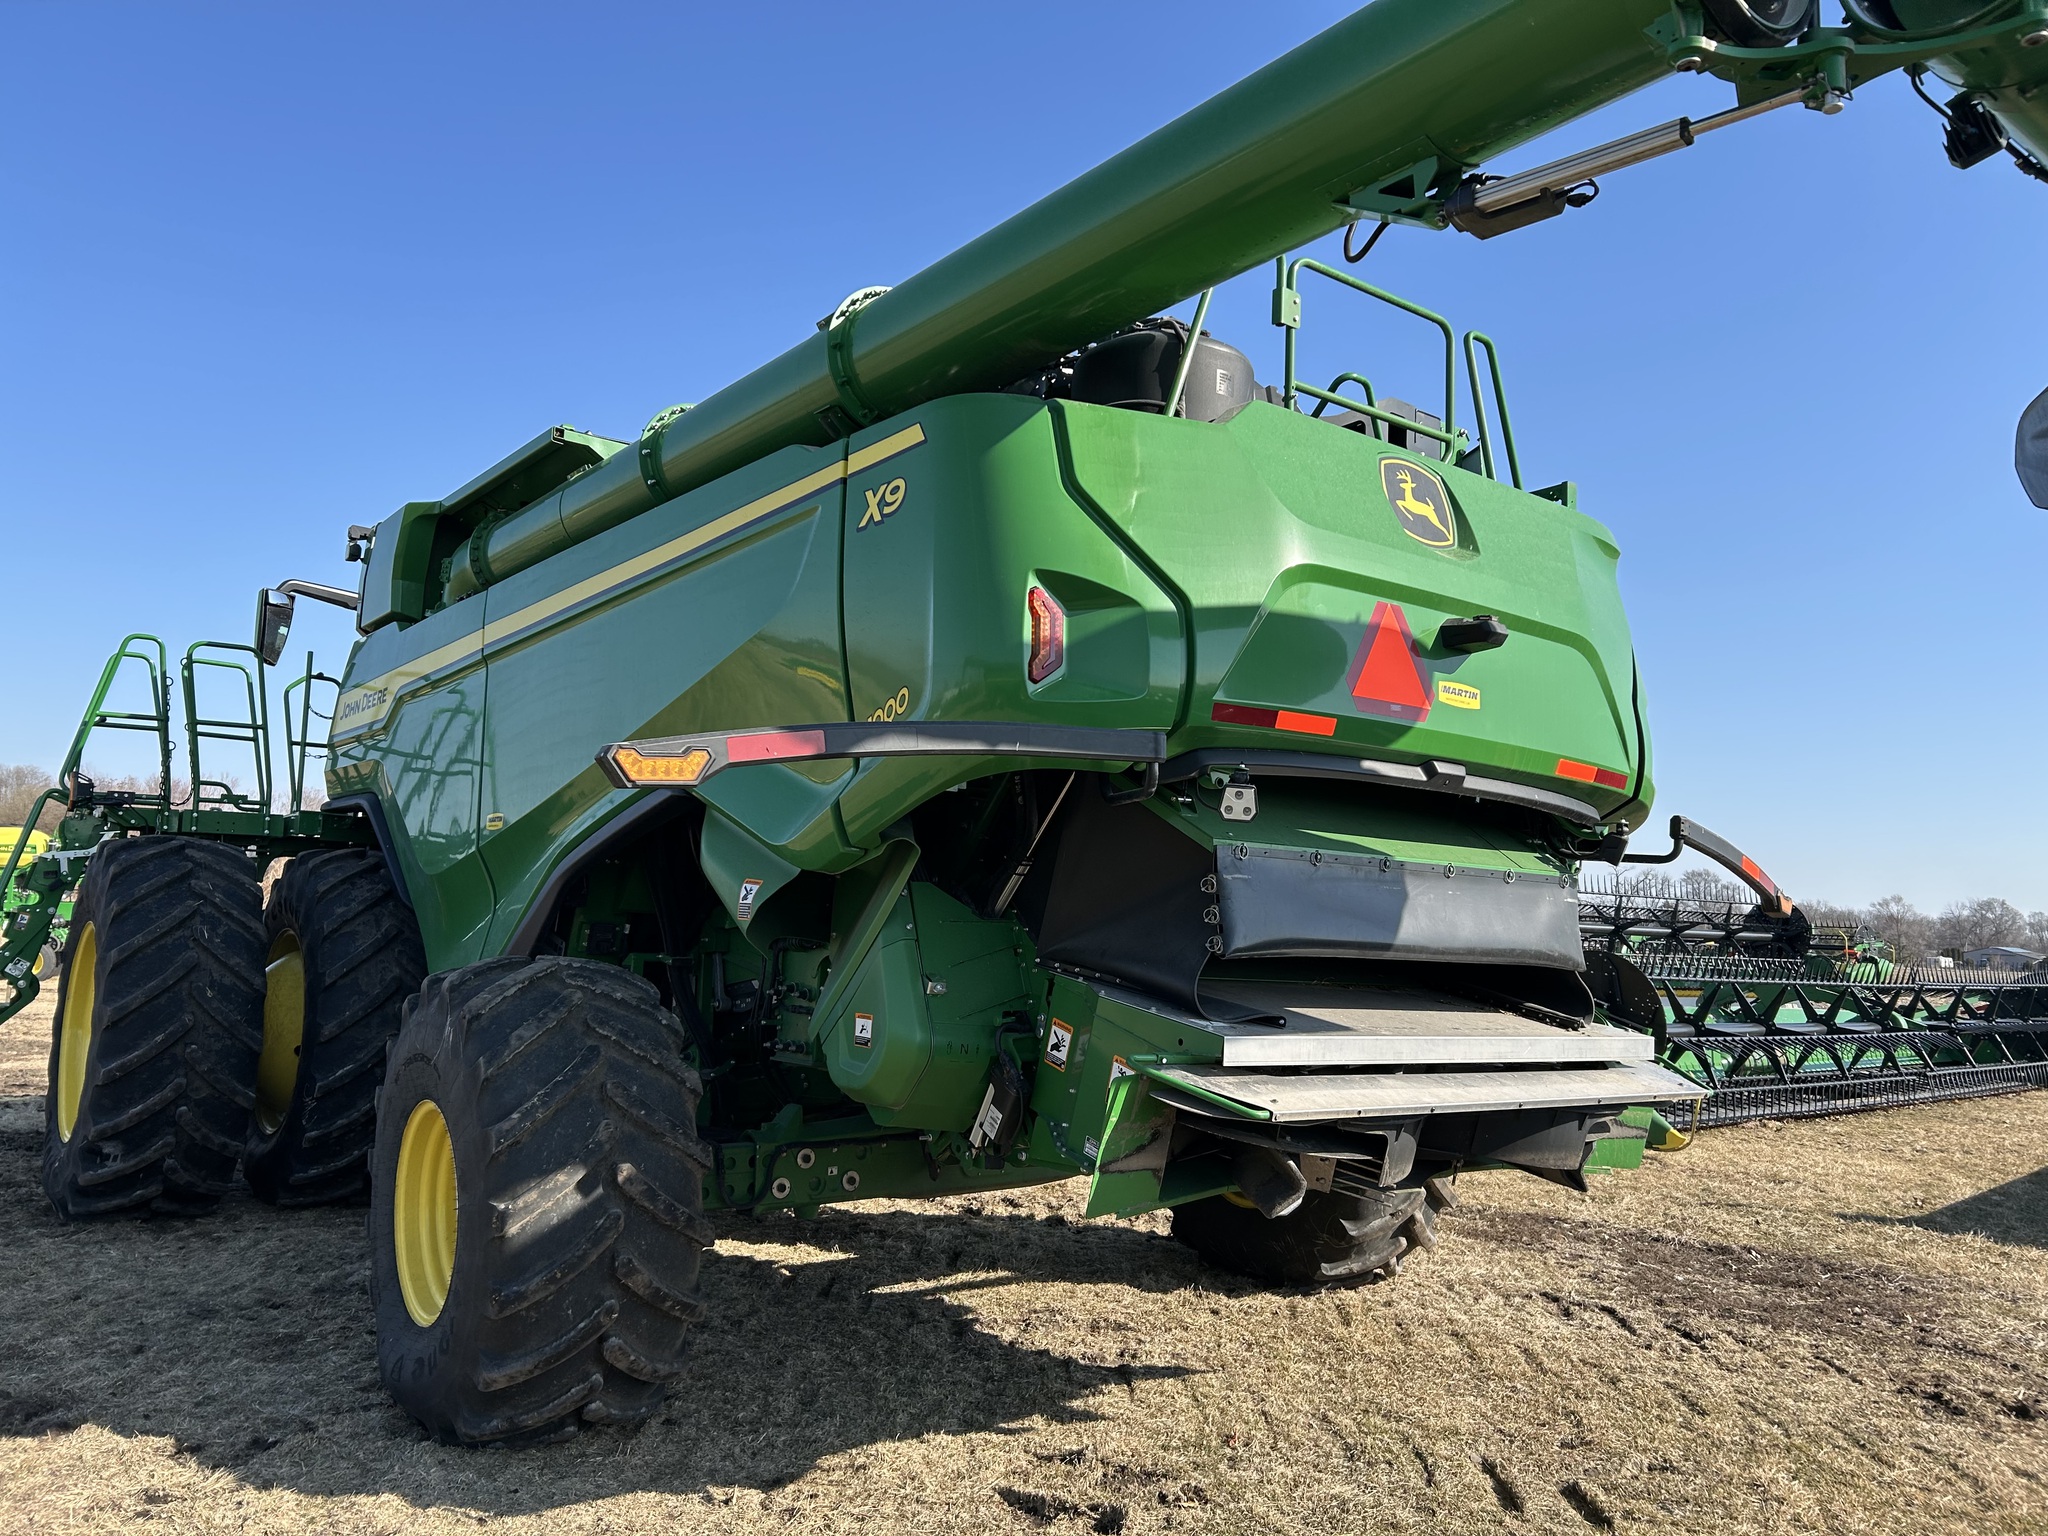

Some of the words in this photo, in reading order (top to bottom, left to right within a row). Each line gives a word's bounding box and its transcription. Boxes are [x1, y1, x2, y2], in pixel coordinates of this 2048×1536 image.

[856, 477, 907, 532] X9
[340, 699, 361, 720] JOHN
[361, 687, 388, 712] DEERE
[867, 686, 909, 723] 000
[1442, 685, 1478, 700] MARTIN
